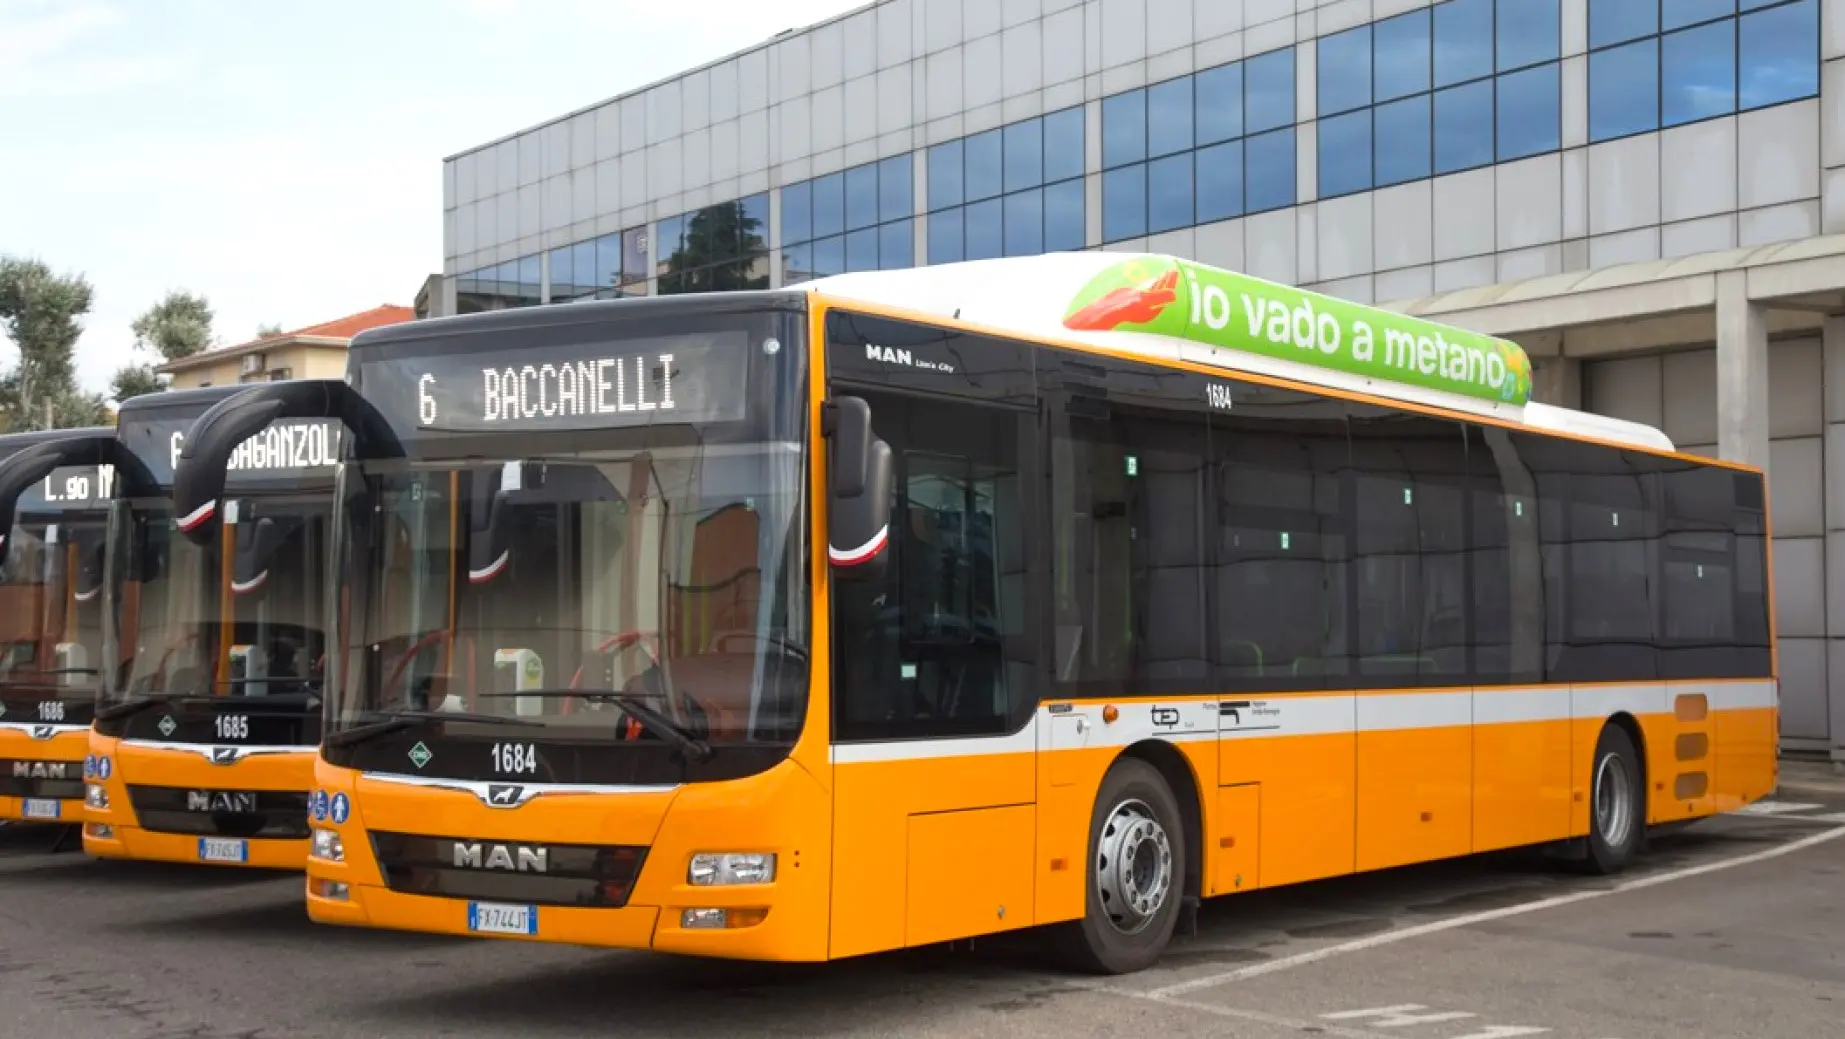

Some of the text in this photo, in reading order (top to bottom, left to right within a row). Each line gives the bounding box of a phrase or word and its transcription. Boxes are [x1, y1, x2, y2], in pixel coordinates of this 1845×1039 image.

[1189, 269, 1506, 388] io vado a metano
[865, 343, 912, 366] MAN
[418, 354, 675, 425] 6 BACCANELLI
[1205, 381, 1233, 410] 1684
[214, 714, 249, 739] 1685
[13, 761, 66, 778] MAN
[491, 742, 537, 774] 1684
[187, 790, 257, 812] MAN
[453, 841, 547, 872] MAN
